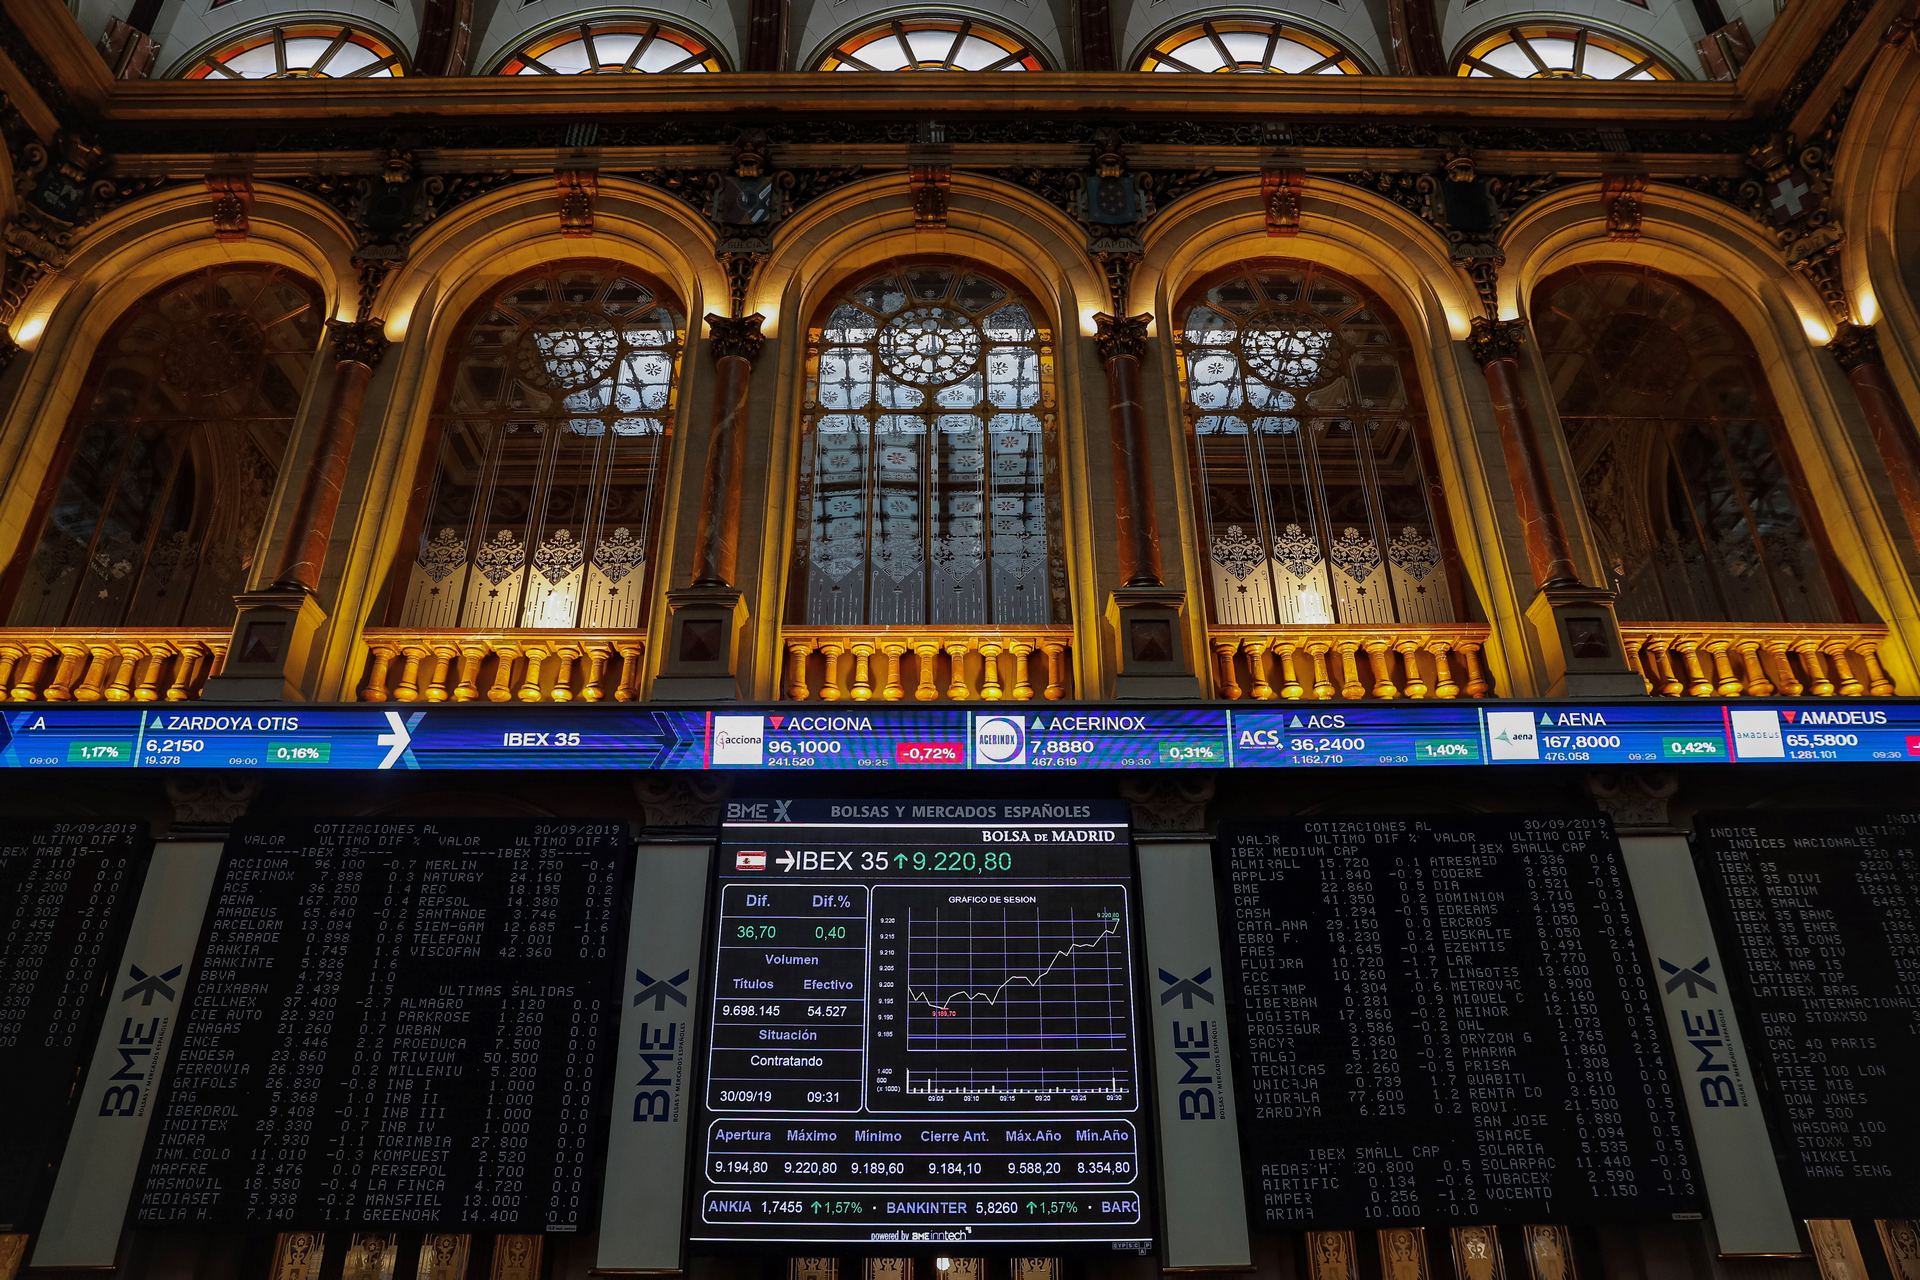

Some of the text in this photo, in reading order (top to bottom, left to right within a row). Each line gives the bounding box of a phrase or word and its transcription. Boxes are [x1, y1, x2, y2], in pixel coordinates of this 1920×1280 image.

[1097, 240, 1133, 248] JAPON
[168, 717, 298, 730] ZARDOYA OTIS
[788, 717, 872, 730] ACCIONA
[1050, 717, 1145, 730] ACERINOX
[1308, 715, 1345, 728] ACS
[1558, 713, 1606, 726] AENA
[1801, 712, 1886, 724] AMADEUS
[504, 733, 580, 746] IBEX 35
[725, 736, 761, 744] acciona
[980, 735, 1014, 744] ACERINOX
[1240, 730, 1279, 746] ACS
[1542, 736, 1620, 749] 167,8000
[1787, 735, 1858, 748] 65,5800
[147, 740, 204, 753] 6,2150
[769, 741, 840, 755] 96,1000
[1031, 741, 1093, 755] 7,8880
[1291, 738, 1364, 752] 36,2400
[1424, 745, 1468, 757] 1,40%
[1672, 743, 1716, 754] 0,42%
[81, 747, 118, 759] 1,17%
[278, 748, 319, 760] 0,16%
[903, 748, 955, 760] -0,72%
[1170, 747, 1213, 760] 0,31%
[1293, 755, 1343, 763] 1.162.710
[1545, 752, 1589, 760] 476.058
[1790, 751, 1836, 759] 1.281.101
[145, 756, 180, 764] 19.378
[768, 758, 814, 766] 241.520
[1032, 758, 1077, 766] 467.619
[727, 804, 1090, 820] BME BOLSAS Y MERCADOS ESPAÑOLES
[54, 824, 136, 833] 30/09/2019
[314, 824, 619, 834] COTIZACIONES AL 30/09/2019
[1305, 819, 1606, 832] COTIZACIONES AL 30/09/2019
[32, 835, 83, 844] ULTIMO
[245, 836, 403, 845] VALOR ULTIMO DIF
[982, 831, 1030, 841] BOLSA
[1052, 831, 1115, 841] MADRID
[1729, 838, 1874, 848] INDICES NACIONALES
[1231, 846, 1358, 857] IBEX MEDIUM CAP
[229, 859, 365, 869] ACCIONA 96.100
[796, 852, 1011, 874] IBEX 35 9.220,80
[1720, 863, 1776, 872] IBEX 35
[1432, 867, 1567, 878] CODERE 3.650
[419, 897, 558, 906] REPSOL 14.380
[747, 895, 850, 907] Dif. Dif.%
[1235, 894, 1374, 906] CAF 41.350
[414, 934, 551, 944] TELEFONI 7.001
[737, 926, 845, 940] 36,70 0,40
[207, 945, 347, 955] BANKIA 1.745
[766, 954, 818, 964] Volumen
[733, 978, 853, 989] Títulos Efectivo
[439, 986, 574, 996] ULTIMAS SALIDAS
[723, 1005, 847, 1016] 9.698.145 54.527
[759, 1029, 816, 1040] Situación
[751, 1055, 822, 1066] Contratando
[1465, 1058, 1609, 1071] PRISA 1.308
[1681, 1010, 1739, 1107] BME
[99, 1018, 159, 1116] BME
[633, 1023, 676, 1122] BME
[1173, 1021, 1216, 1120] BME
[720, 1091, 838, 1102] 30/09/19 09:31
[1784, 1093, 1867, 1105] DOW JONES
[163, 1120, 312, 1131] INDITEX 28.330
[1793, 1121, 1886, 1133] NASDAQ 100
[716, 1129, 1128, 1142] Apertura Máximo Mínimo Cierre Ant. Máx.Año Mín.Año
[1801, 1151, 1857, 1162] NIKKEI
[716, 1161, 1130, 1175] 9.194,80 9.220,80 9.189,60 9.184,10 9.588,20 8.354,80
[1805, 1165, 1891, 1176] HANG SENG
[708, 1201, 751, 1212] ANKIA
[762, 1201, 802, 1214] 1,7455
[825, 1202, 862, 1215] 1,57%
[887, 1202, 967, 1213] BANKINTER
[976, 1202, 1017, 1215] 5,8260
[1040, 1202, 1077, 1215] 1,57%
[871, 1230, 898, 1240] powered
[901, 1230, 909, 1240] by
